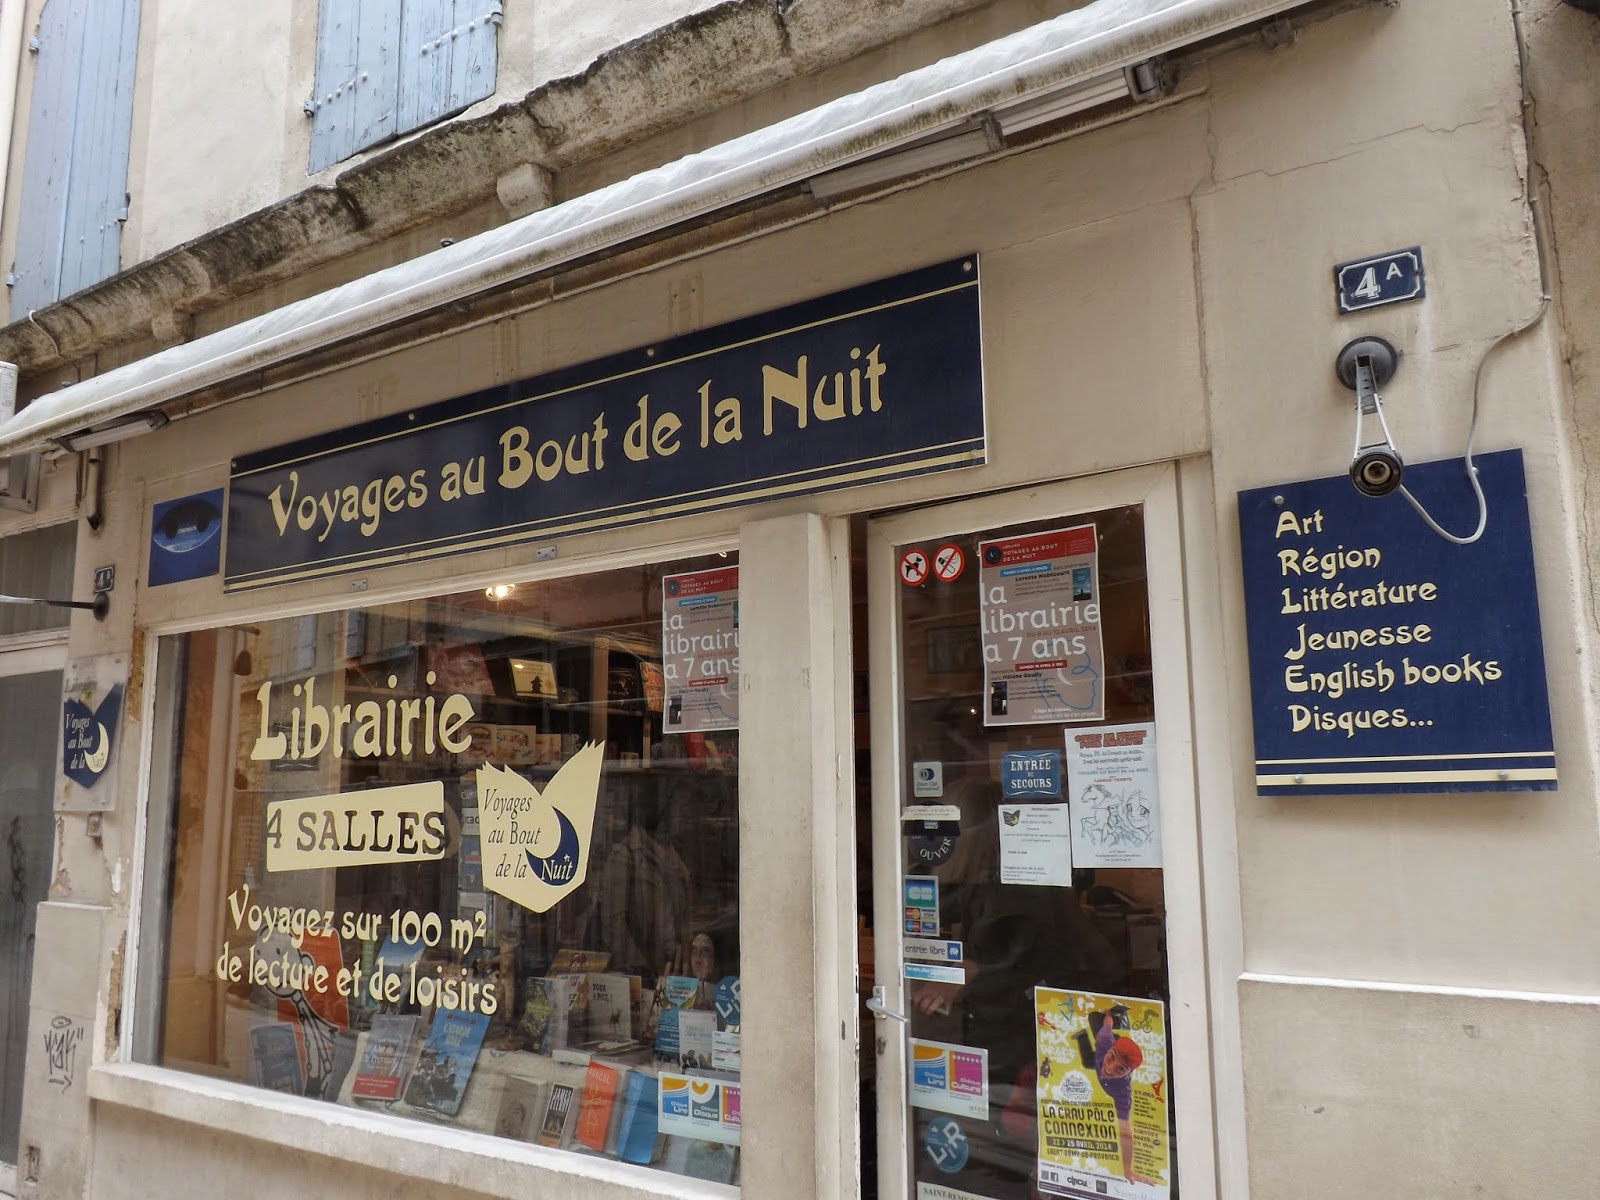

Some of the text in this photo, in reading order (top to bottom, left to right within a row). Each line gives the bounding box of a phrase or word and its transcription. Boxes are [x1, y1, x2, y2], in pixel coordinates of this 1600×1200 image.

[1353, 262, 1403, 299] 4 A
[268, 343, 886, 542] Voyages au Bout de la Nuit
[1275, 509, 1324, 538] Art
[1277, 545, 1381, 580] Région
[981, 583, 1007, 606] la
[1280, 580, 1437, 614] Littérature
[663, 611, 684, 631] la
[982, 601, 1100, 635] librairie
[984, 635, 1086, 662] a 7 ans
[1284, 623, 1432, 661] Jeunesse
[665, 663, 678, 679] a
[683, 657, 694, 677] 7
[1284, 653, 1502, 699] English books
[250, 671, 476, 760] Librairie
[1287, 705, 1434, 738] Disques...
[1010, 757, 1050, 771] ENTRÉE
[1010, 778, 1052, 789] SECOURS
[483, 788, 532, 820] Voyages
[267, 808, 445, 855] 4 SALLES
[487, 821, 541, 845] au Bout
[920, 836, 952, 860] OUVER
[495, 853, 574, 881] de la Nuit
[228, 884, 335, 948] Voyagez
[342, 911, 381, 940] sur
[390, 909, 442, 948] 100
[905, 945, 946, 955] entrée libre
[216, 942, 498, 1016] de lecture et de loisirs
[1042, 1106, 1056, 1119] LA
[1058, 1107, 1085, 1121] CRAU
[1076, 1140, 1094, 1148] AVRIL
[1096, 1142, 1112, 1150] 2014
